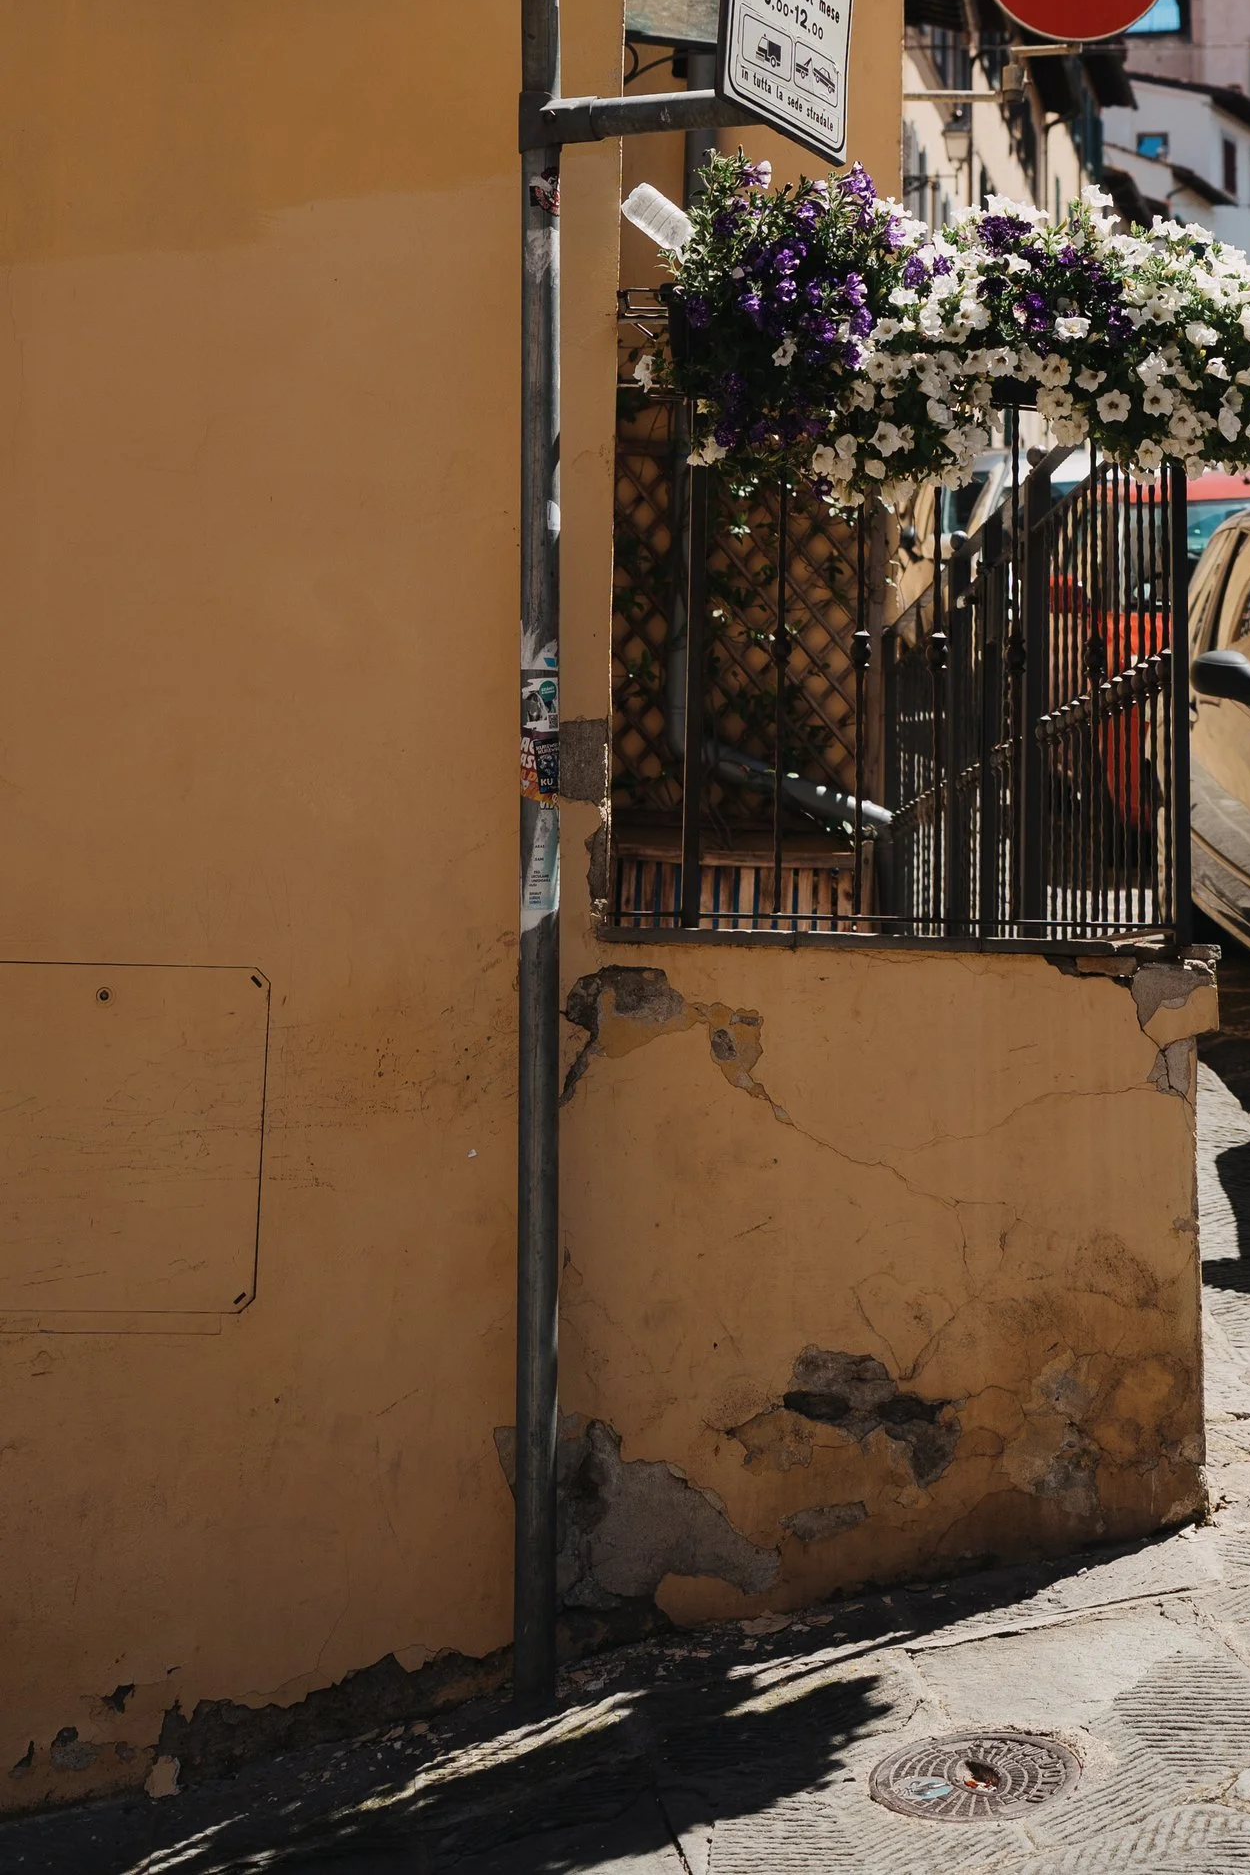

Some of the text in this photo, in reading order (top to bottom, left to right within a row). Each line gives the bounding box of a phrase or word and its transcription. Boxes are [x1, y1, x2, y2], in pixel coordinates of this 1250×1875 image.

[819, 0, 840, 25] mese
[741, 68, 834, 131] in tutta la sede stradale
